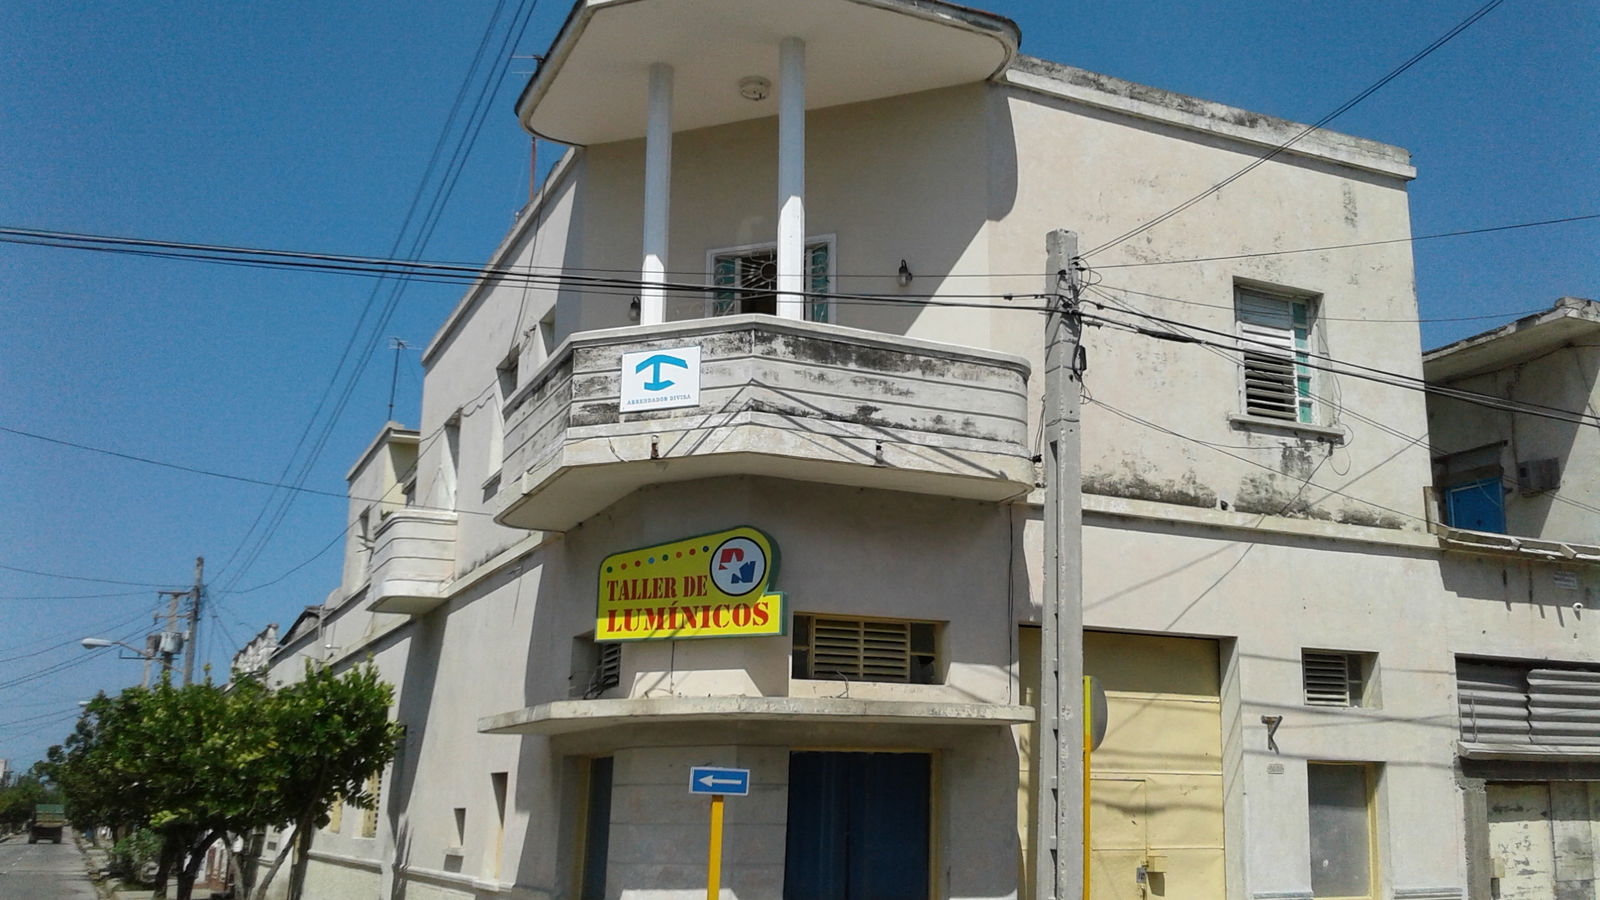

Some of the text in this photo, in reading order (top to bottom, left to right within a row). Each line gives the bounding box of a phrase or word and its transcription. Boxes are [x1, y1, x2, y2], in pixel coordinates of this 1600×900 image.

[627, 396, 668, 405] ARRENDADOR
[607, 575, 708, 602] TALLER DE
[607, 601, 769, 633] LUMÍNICOS
